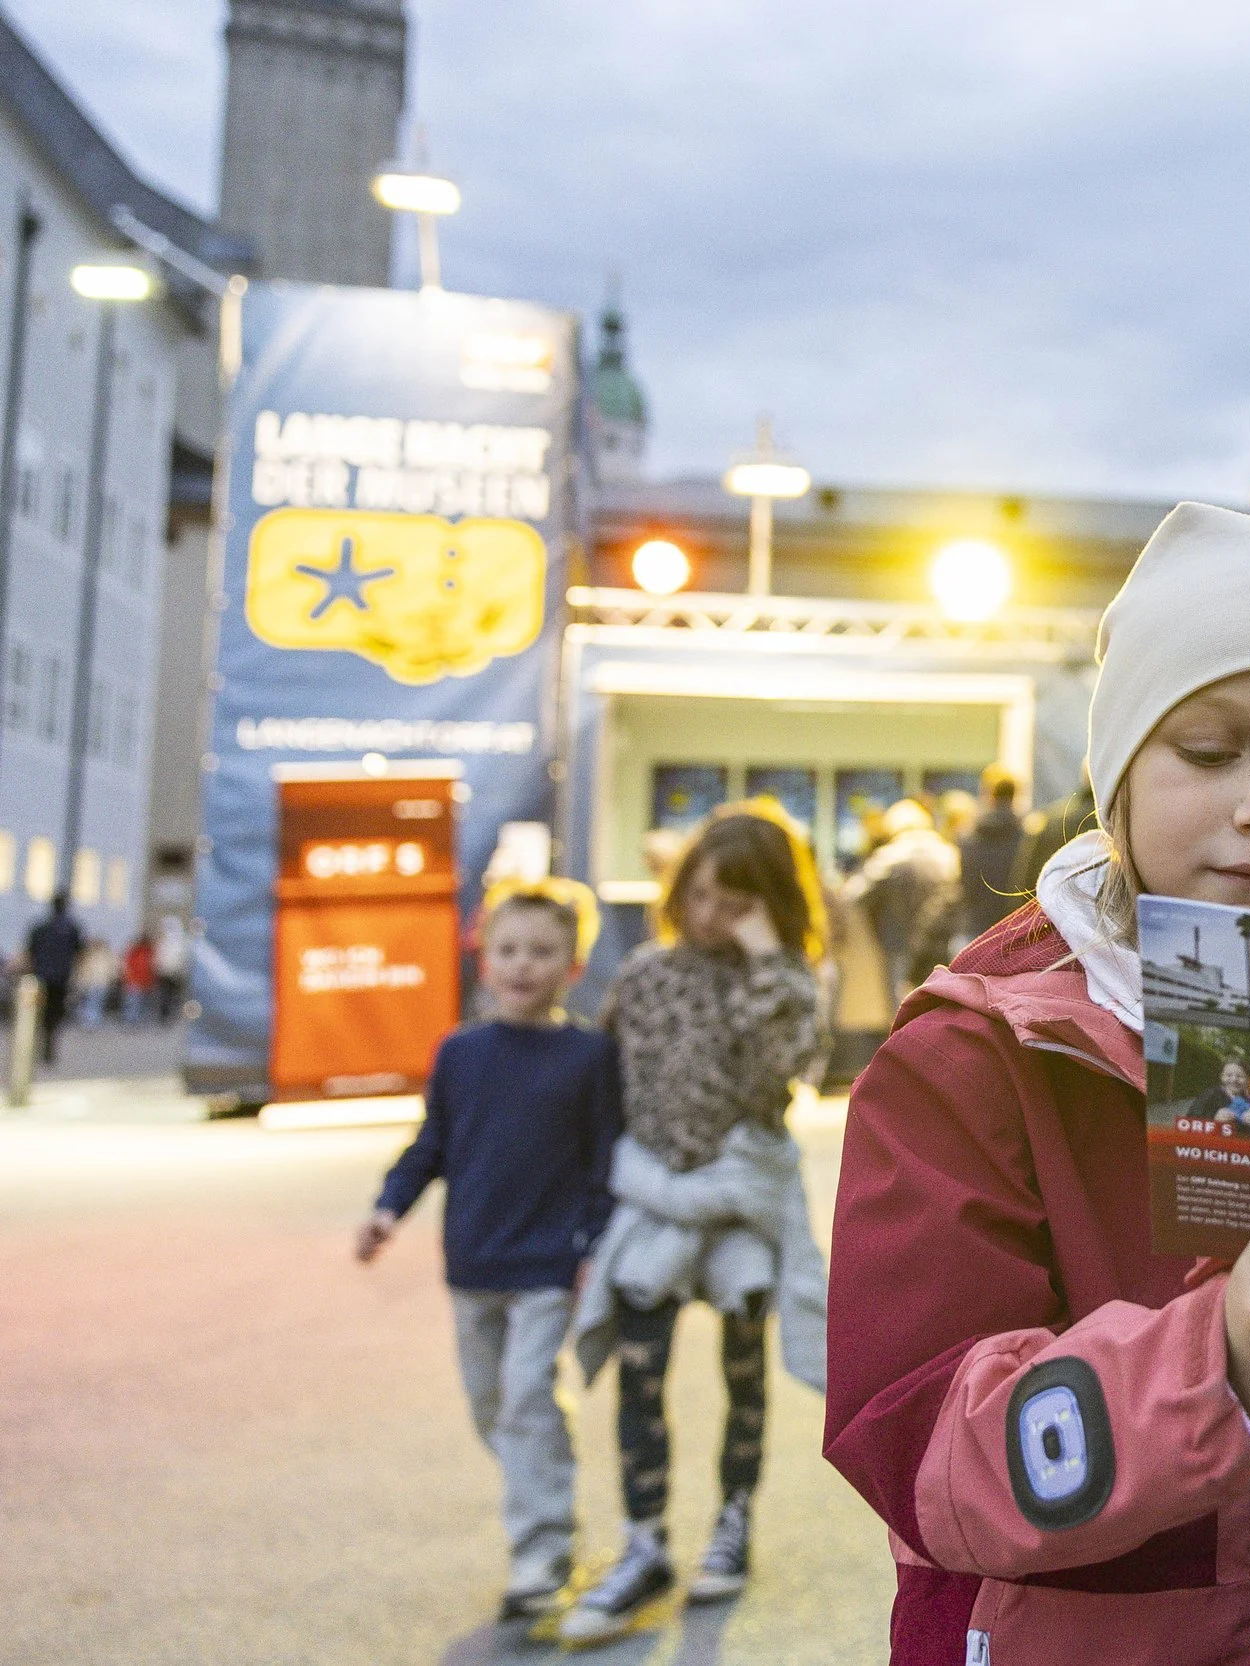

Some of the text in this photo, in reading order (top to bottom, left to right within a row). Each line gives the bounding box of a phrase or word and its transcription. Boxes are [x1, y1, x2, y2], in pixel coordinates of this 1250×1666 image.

[1177, 1118, 1216, 1133] ORF
[1175, 1145, 1202, 1160] WO
[1204, 1148, 1229, 1164] ICH
